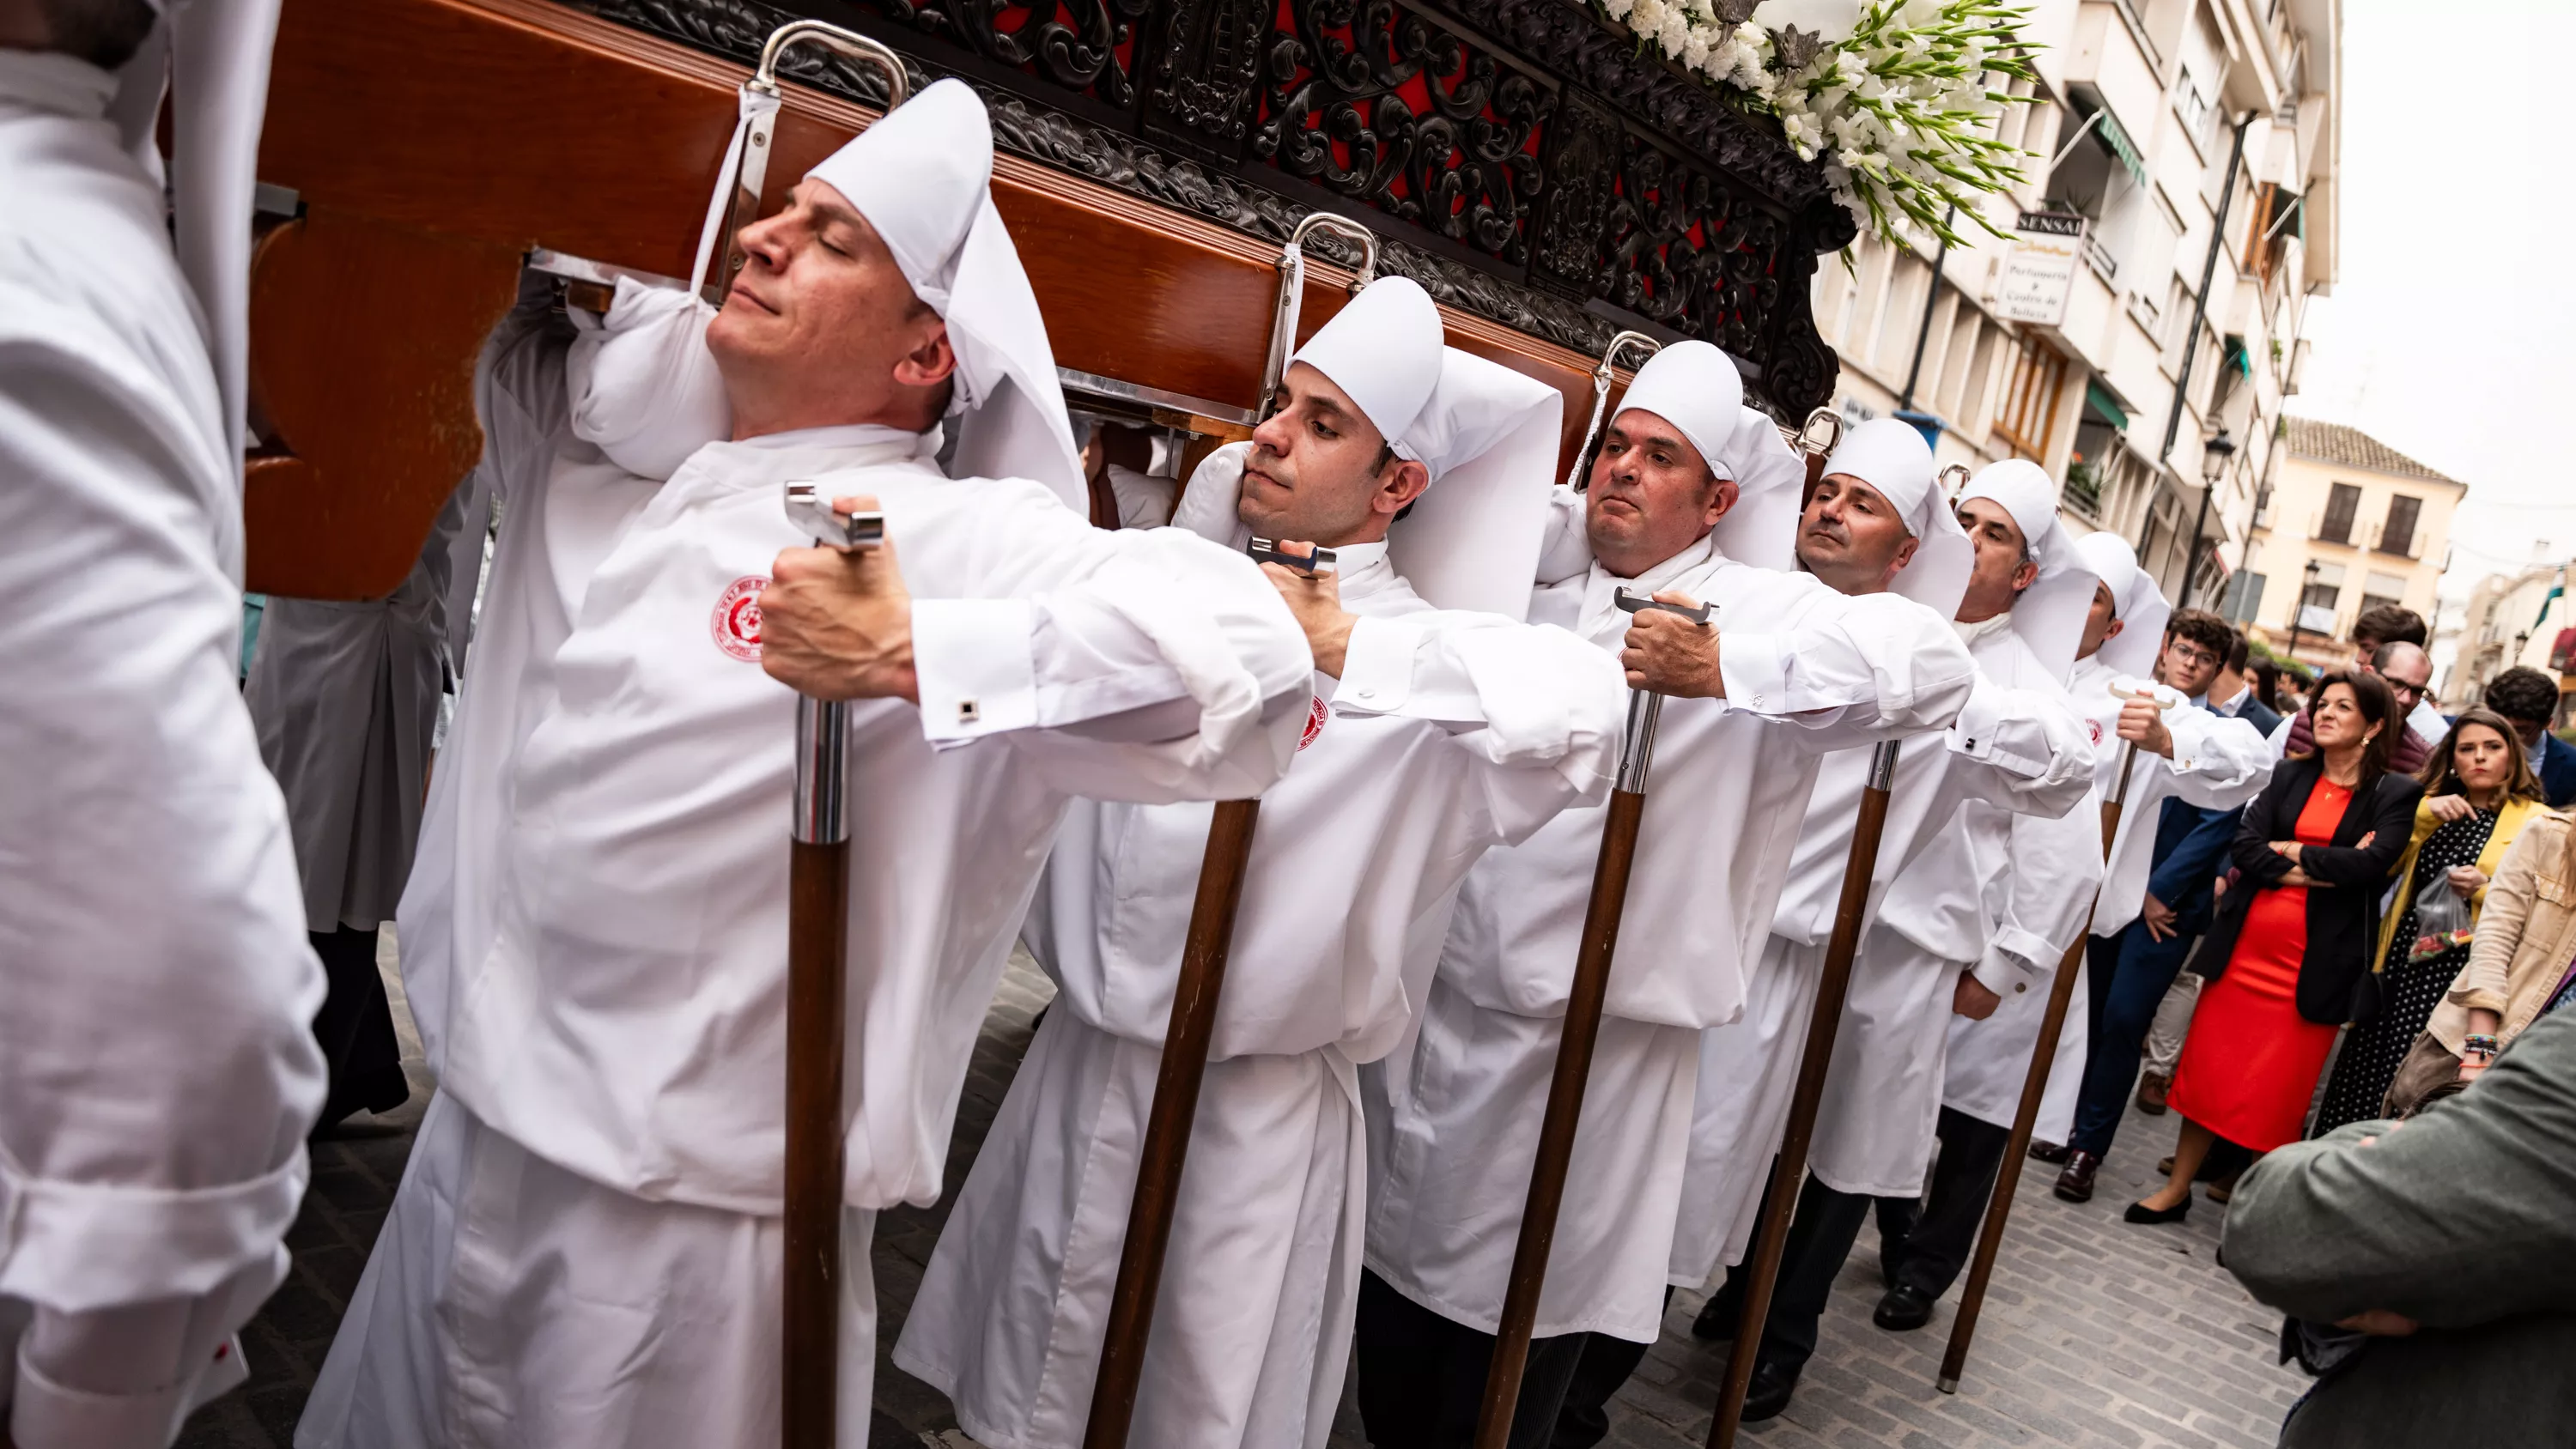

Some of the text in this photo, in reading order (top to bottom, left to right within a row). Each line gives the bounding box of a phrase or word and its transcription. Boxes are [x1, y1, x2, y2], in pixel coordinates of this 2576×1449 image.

[2019, 215, 2081, 234] SENSAI
[2007, 292, 2057, 306] Centro de
[2010, 306, 2048, 318] Belleza
